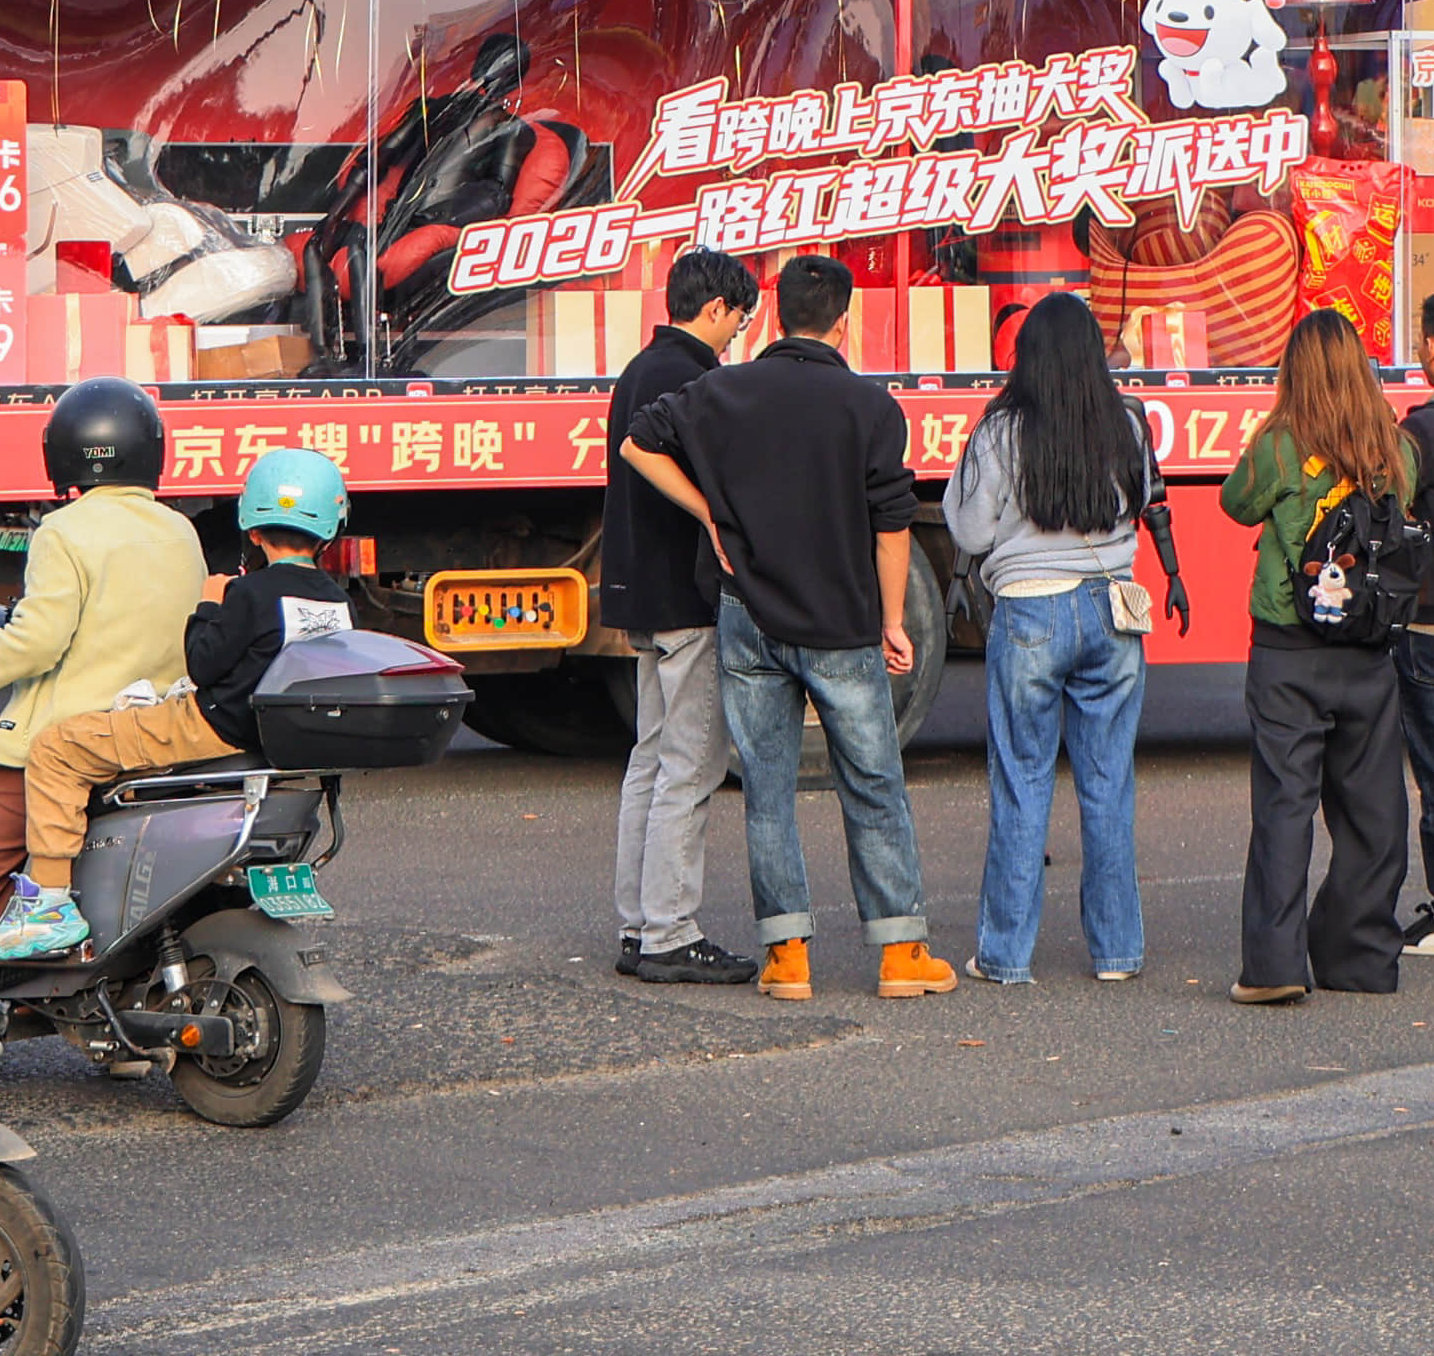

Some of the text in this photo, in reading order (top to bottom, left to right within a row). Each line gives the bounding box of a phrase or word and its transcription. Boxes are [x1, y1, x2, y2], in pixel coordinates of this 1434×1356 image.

[616, 46, 1148, 204] 看跨晚上京东抽大奖
